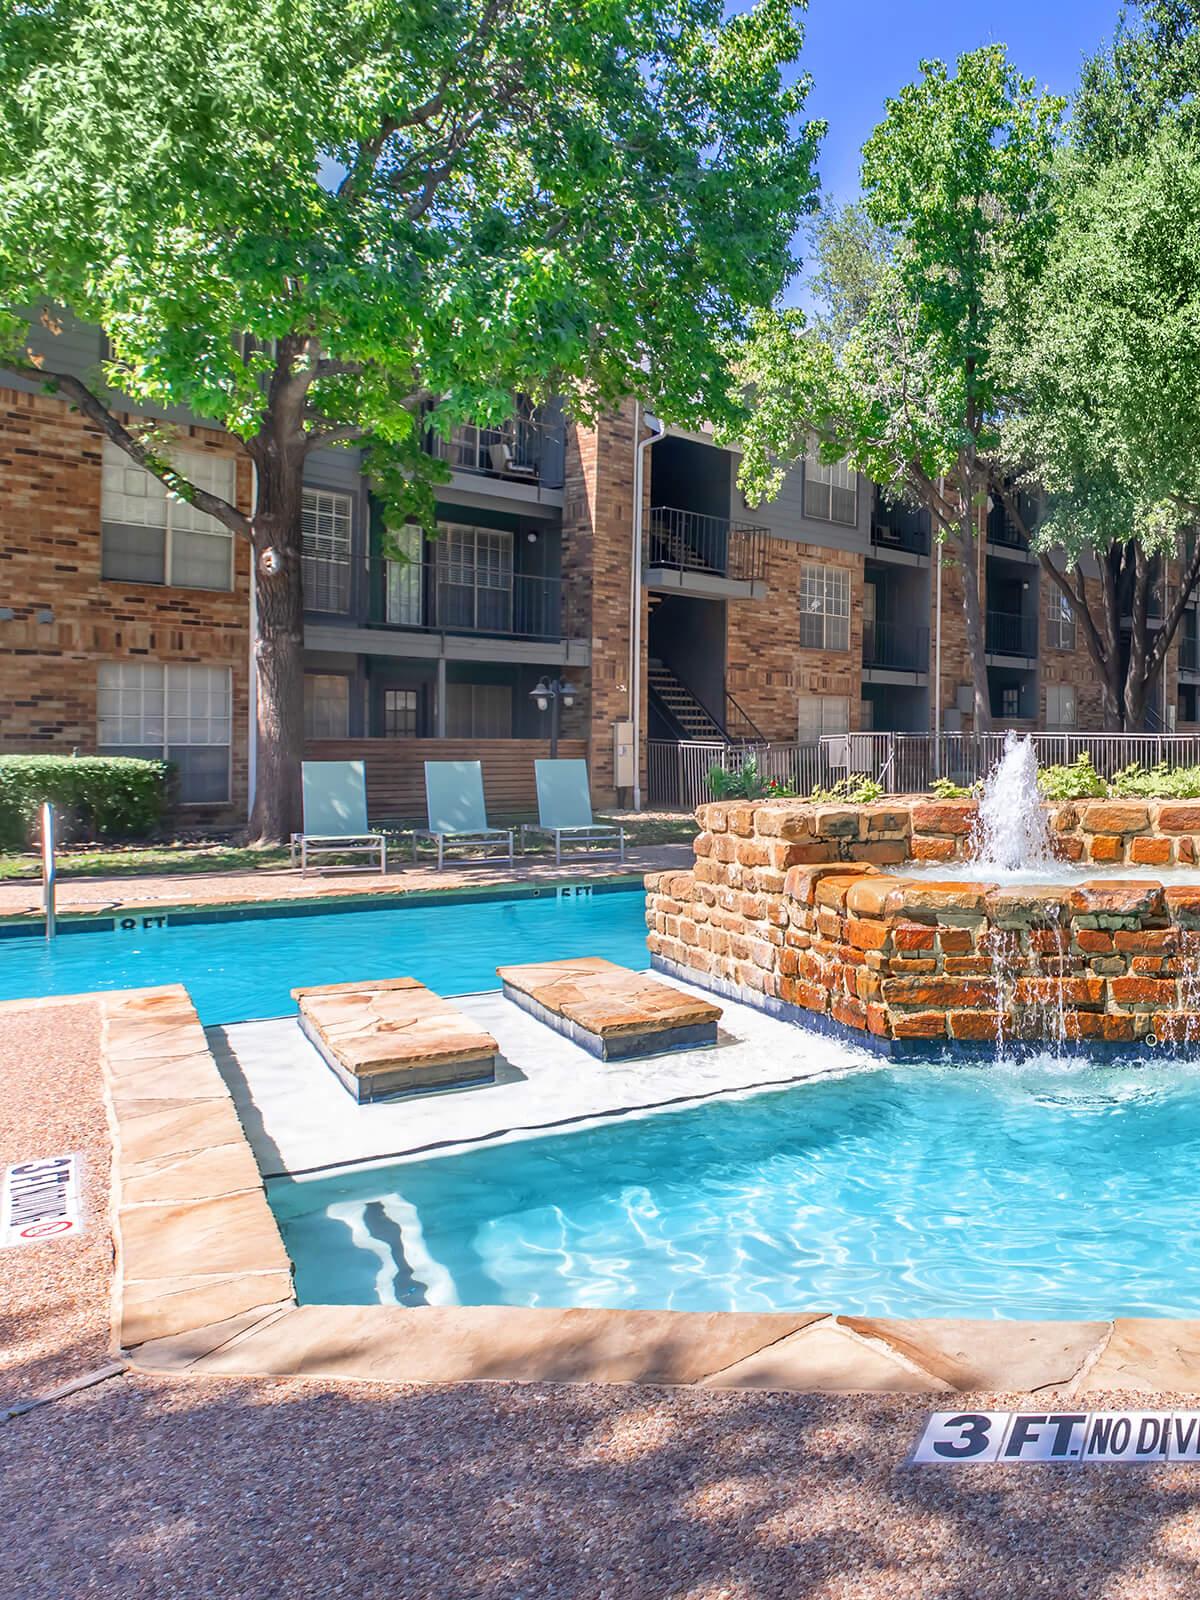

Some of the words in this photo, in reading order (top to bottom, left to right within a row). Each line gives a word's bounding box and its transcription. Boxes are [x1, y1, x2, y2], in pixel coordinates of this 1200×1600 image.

[11, 1158, 72, 1176] 3
[933, 1414, 992, 1458] 3
[1004, 1415, 1087, 1457] FT.
[1087, 1418, 1132, 1455] NO
